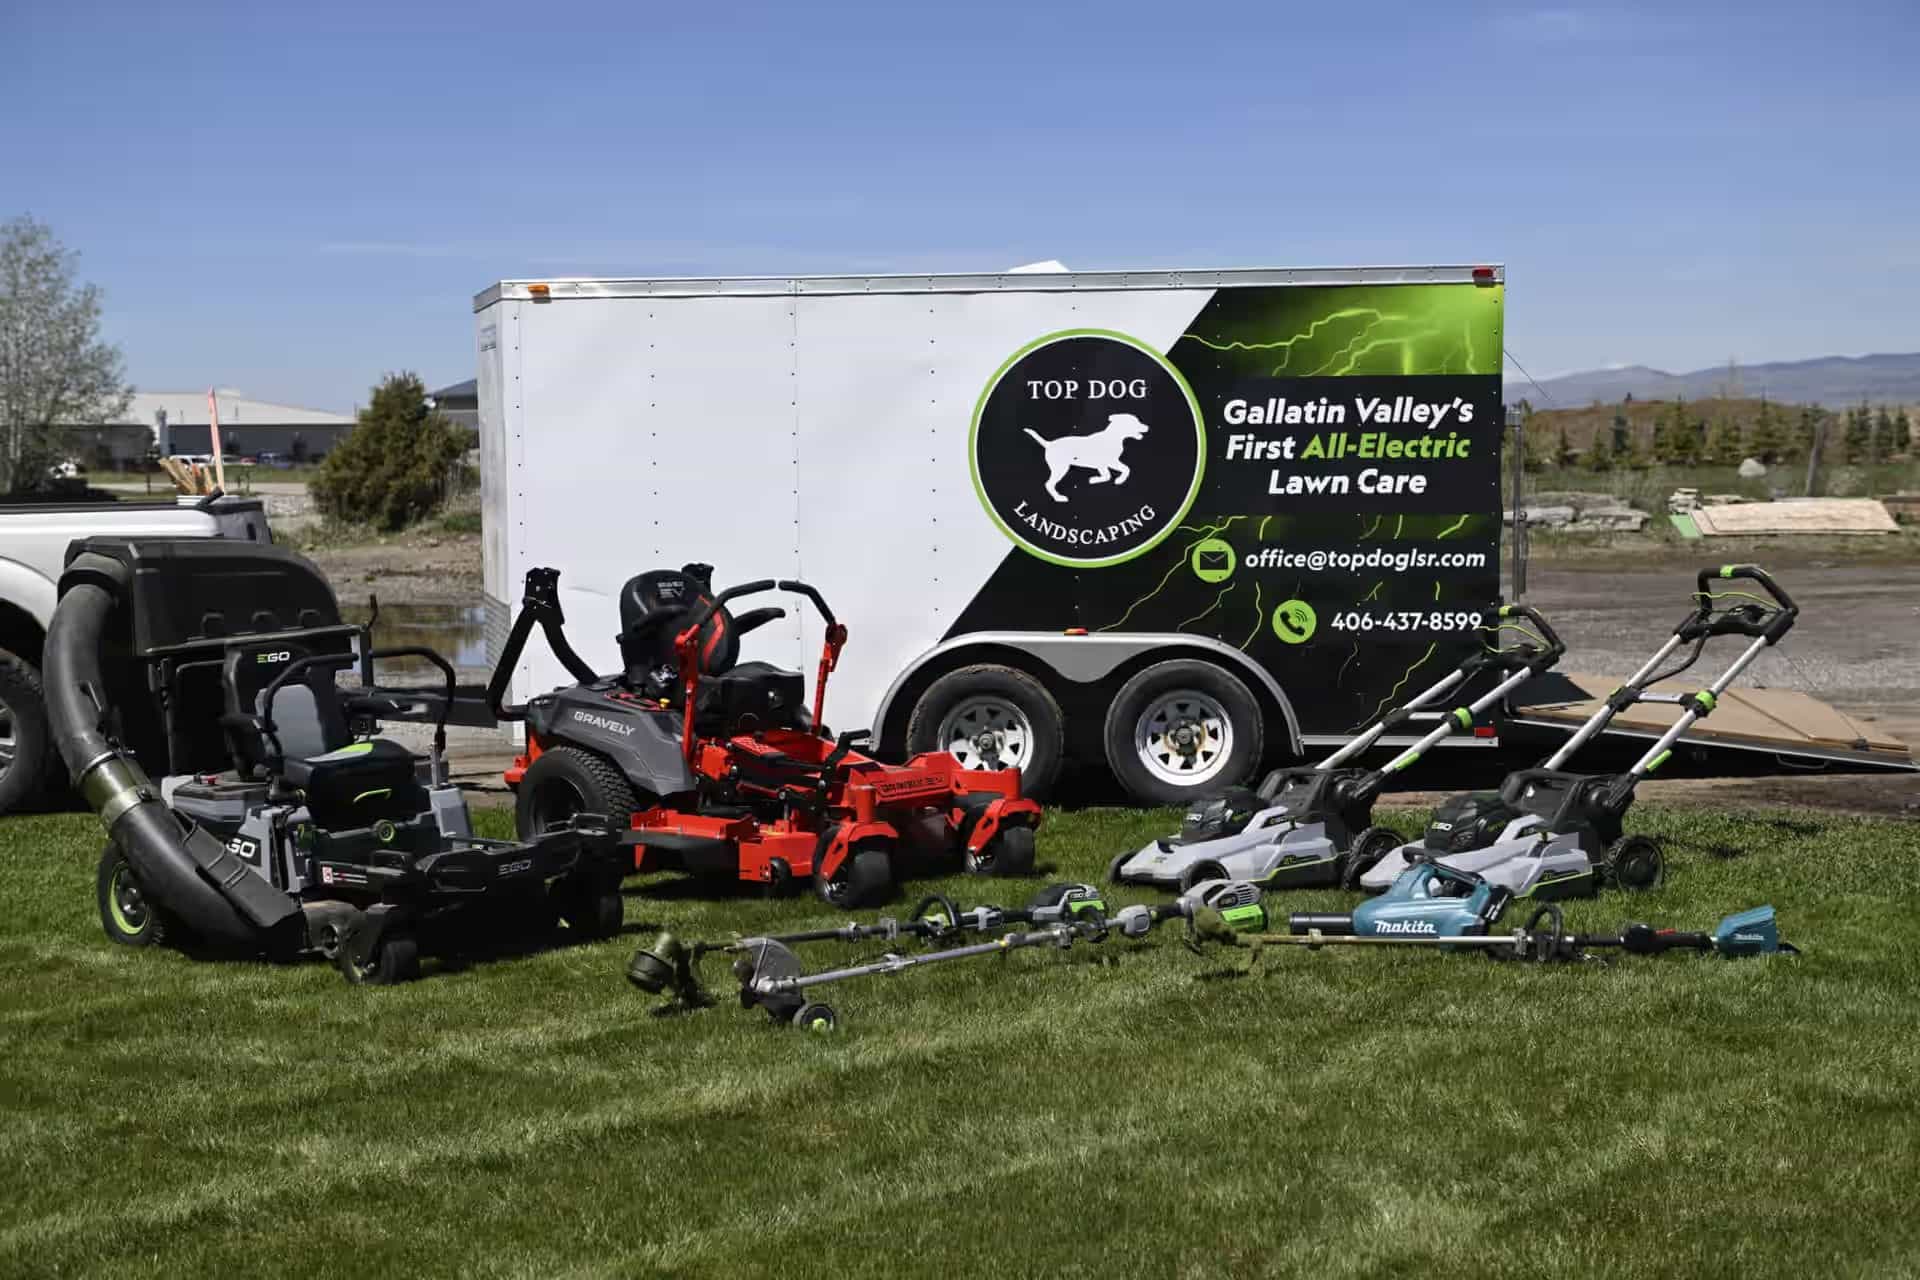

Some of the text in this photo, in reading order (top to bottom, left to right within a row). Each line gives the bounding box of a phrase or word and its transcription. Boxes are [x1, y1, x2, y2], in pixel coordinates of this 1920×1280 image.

[1027, 379, 1147, 399] TOP DOG
[1223, 397, 1474, 429] Gallatin Valley's
[1225, 432, 1470, 460] First All-Electric
[1268, 468, 1427, 495] Lawn Care
[1013, 500, 1156, 545] LANDSCAPING
[1245, 549, 1486, 572] office@topdoglsr.com
[1330, 612, 1482, 631] 406-437-8599
[257, 651, 290, 664] EGO
[574, 711, 636, 736] GRAVELY
[226, 837, 256, 858] GO
